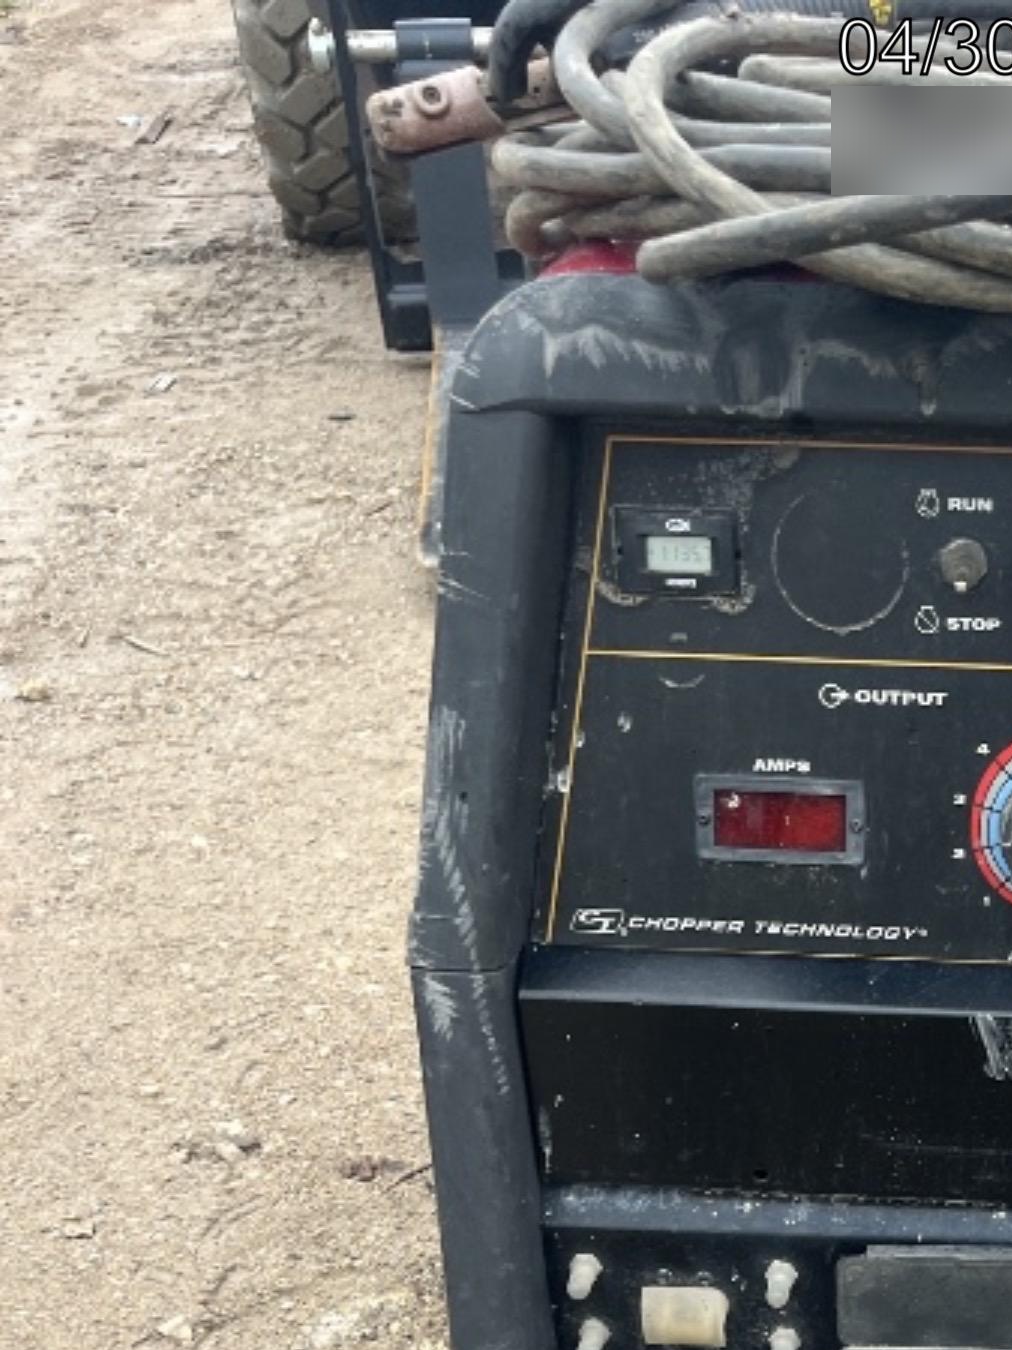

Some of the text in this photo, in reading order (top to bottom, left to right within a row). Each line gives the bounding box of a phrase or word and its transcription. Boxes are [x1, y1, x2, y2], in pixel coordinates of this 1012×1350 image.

[946, 496, 995, 513] RUN
[946, 616, 1001, 632] STOP
[854, 689, 949, 706] OUTPUT
[752, 757, 811, 773] AMPS
[627, 916, 745, 934] CHOPPER
